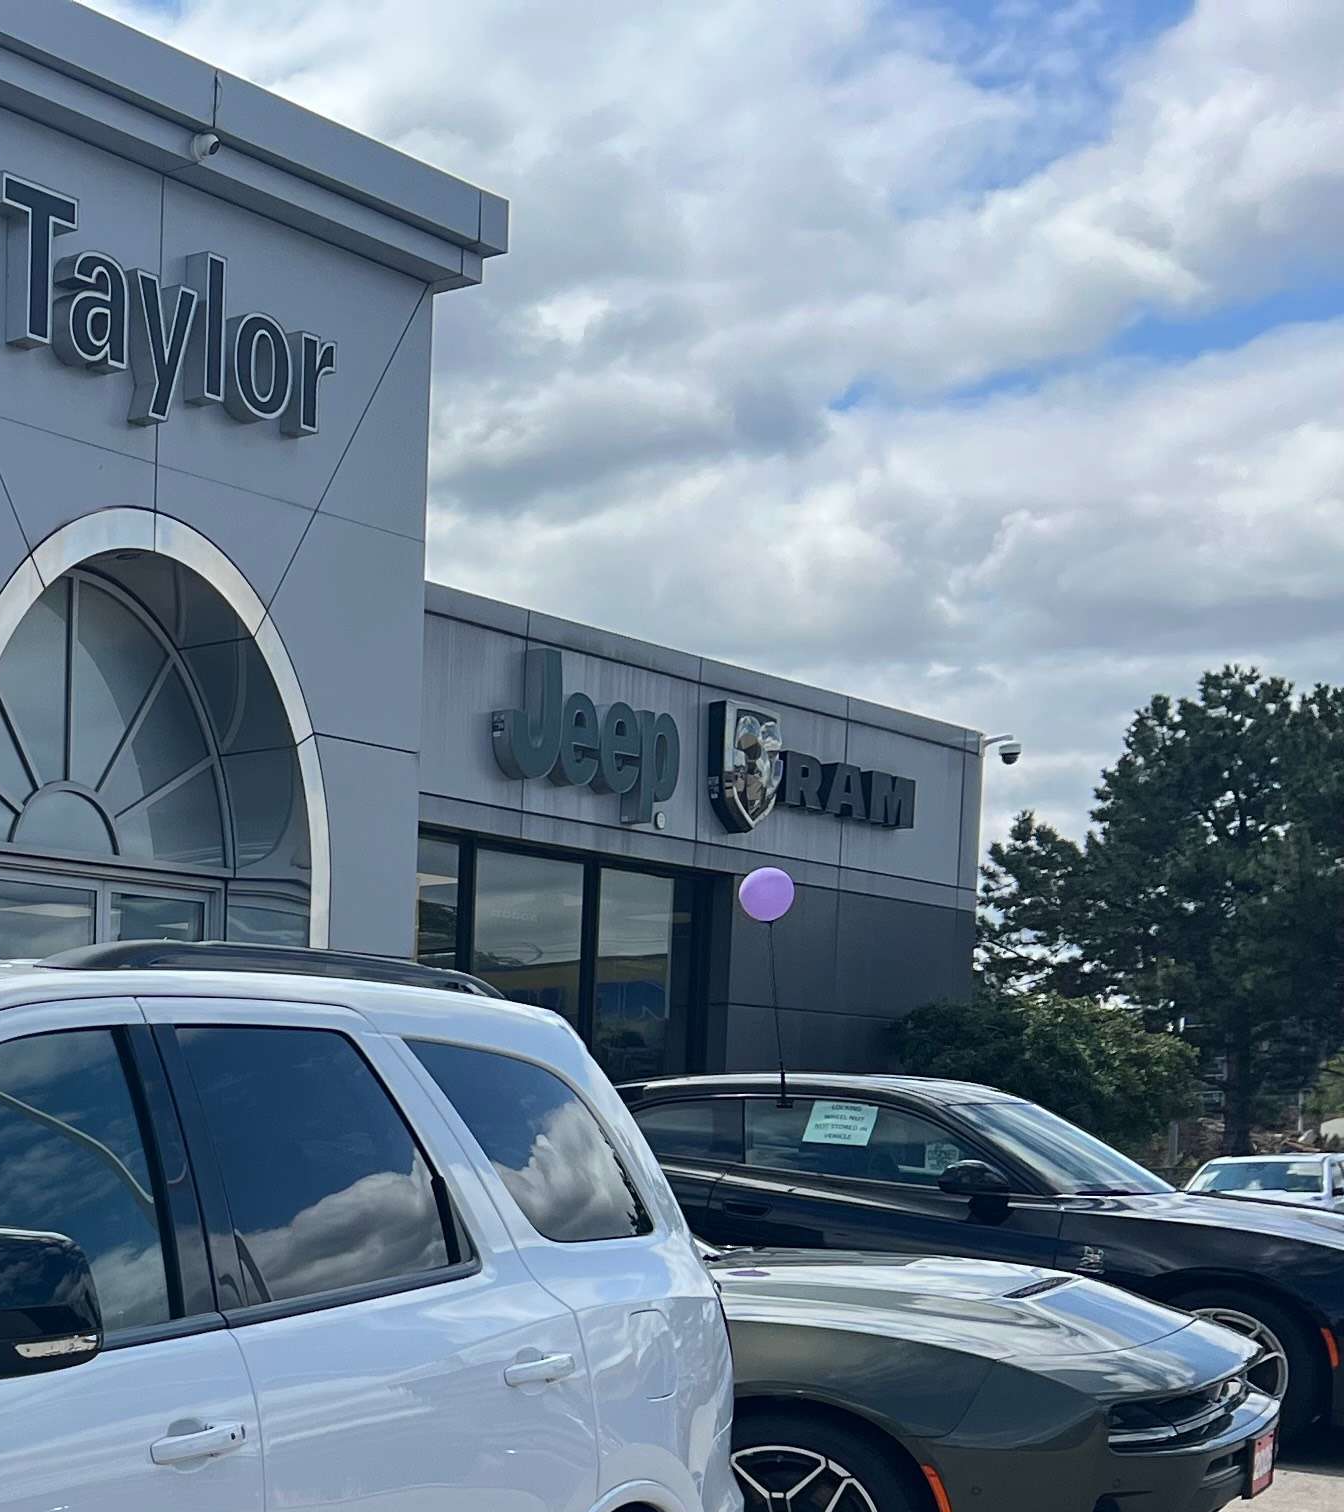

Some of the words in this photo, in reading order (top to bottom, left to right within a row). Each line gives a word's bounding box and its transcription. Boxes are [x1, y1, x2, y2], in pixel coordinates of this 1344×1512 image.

[491, 648, 680, 824] Jeep
[779, 750, 916, 828] RAM
[831, 1103, 863, 1112] LOCKING
